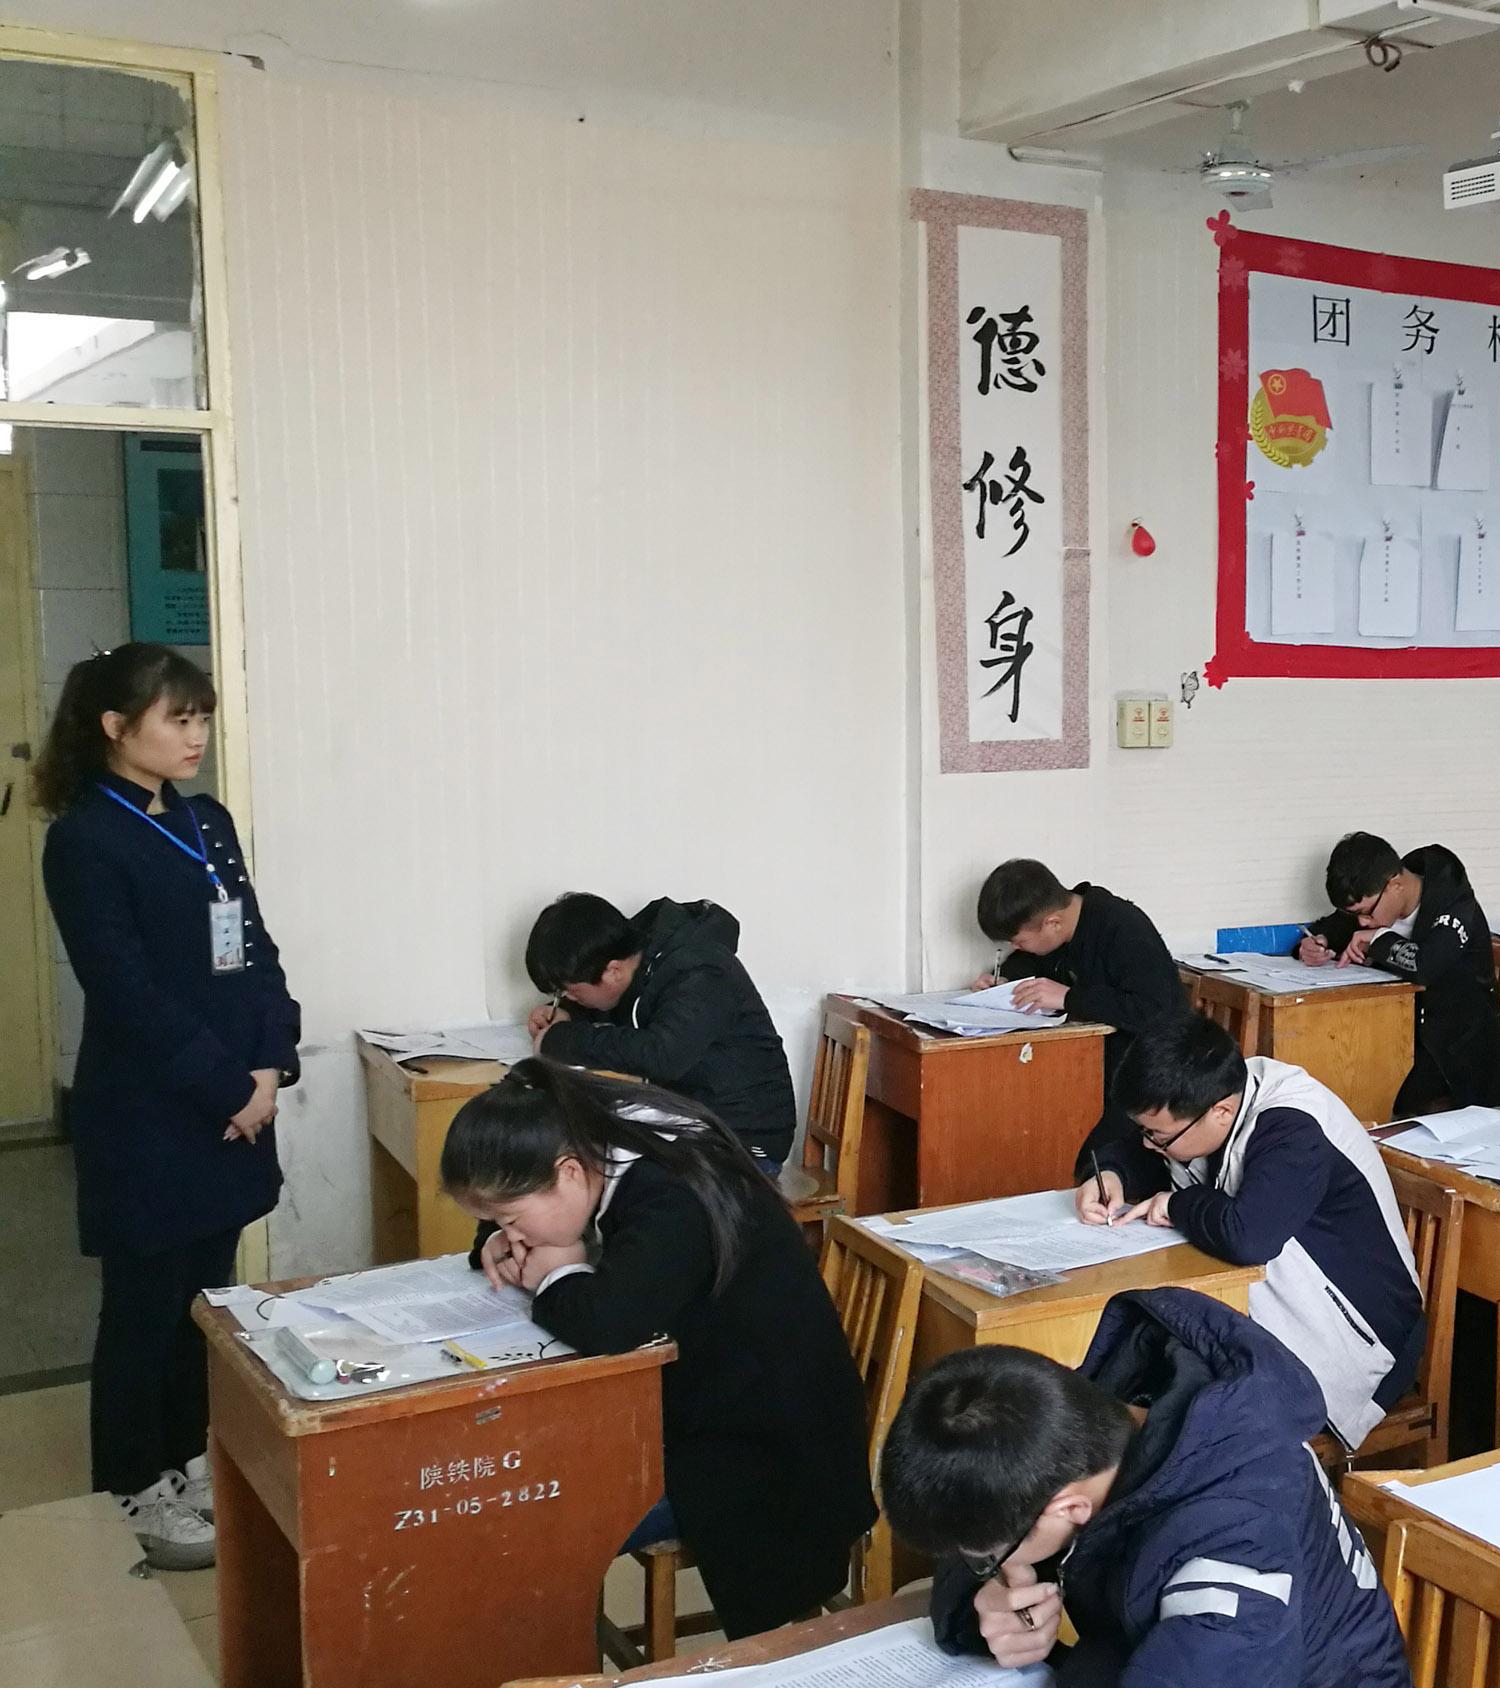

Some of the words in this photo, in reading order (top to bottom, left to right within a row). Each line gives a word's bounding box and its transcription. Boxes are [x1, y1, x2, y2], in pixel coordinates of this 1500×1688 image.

[963, 304, 1047, 724] 德修身
[394, 1480, 561, 1531] Z31-05-2822
